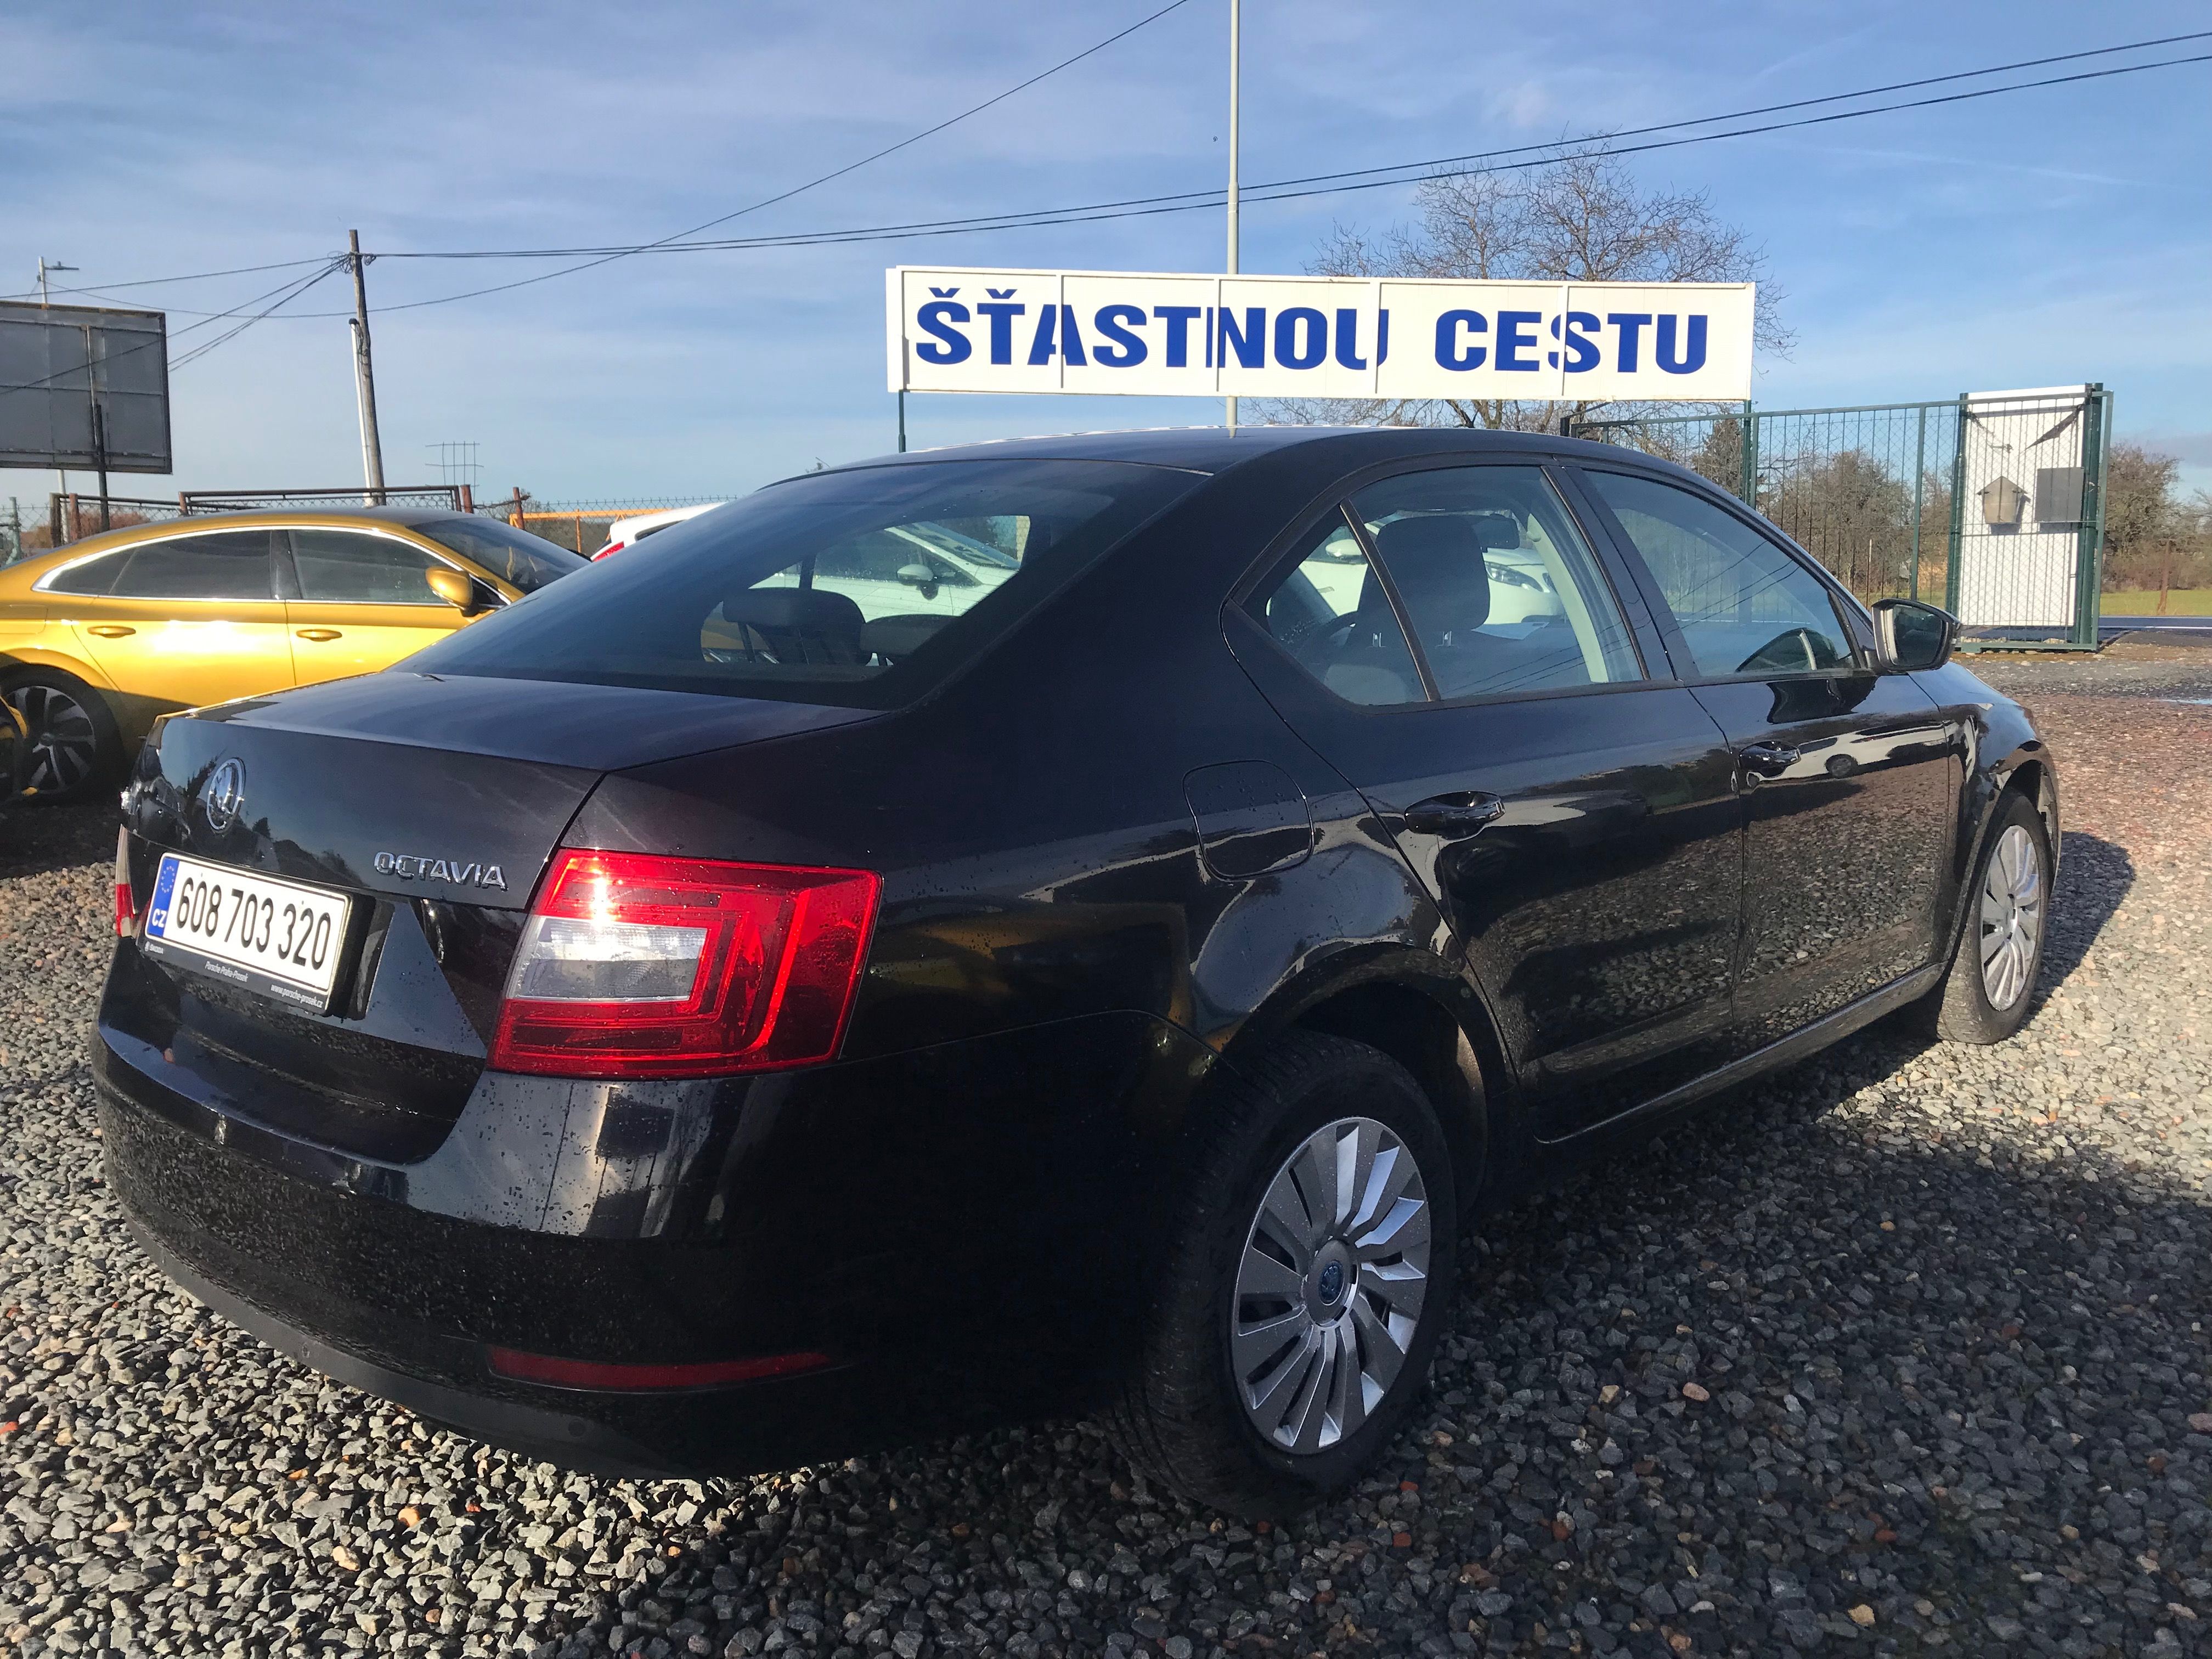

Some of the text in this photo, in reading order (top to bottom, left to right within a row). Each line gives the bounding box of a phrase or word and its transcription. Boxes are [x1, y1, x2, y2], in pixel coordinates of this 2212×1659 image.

[916, 287, 1708, 375] ŠŤASTNOU CESTU
[374, 851, 509, 892] OCTAVIA
[151, 907, 167, 929] CZ
[176, 877, 331, 970] 608 703 320
